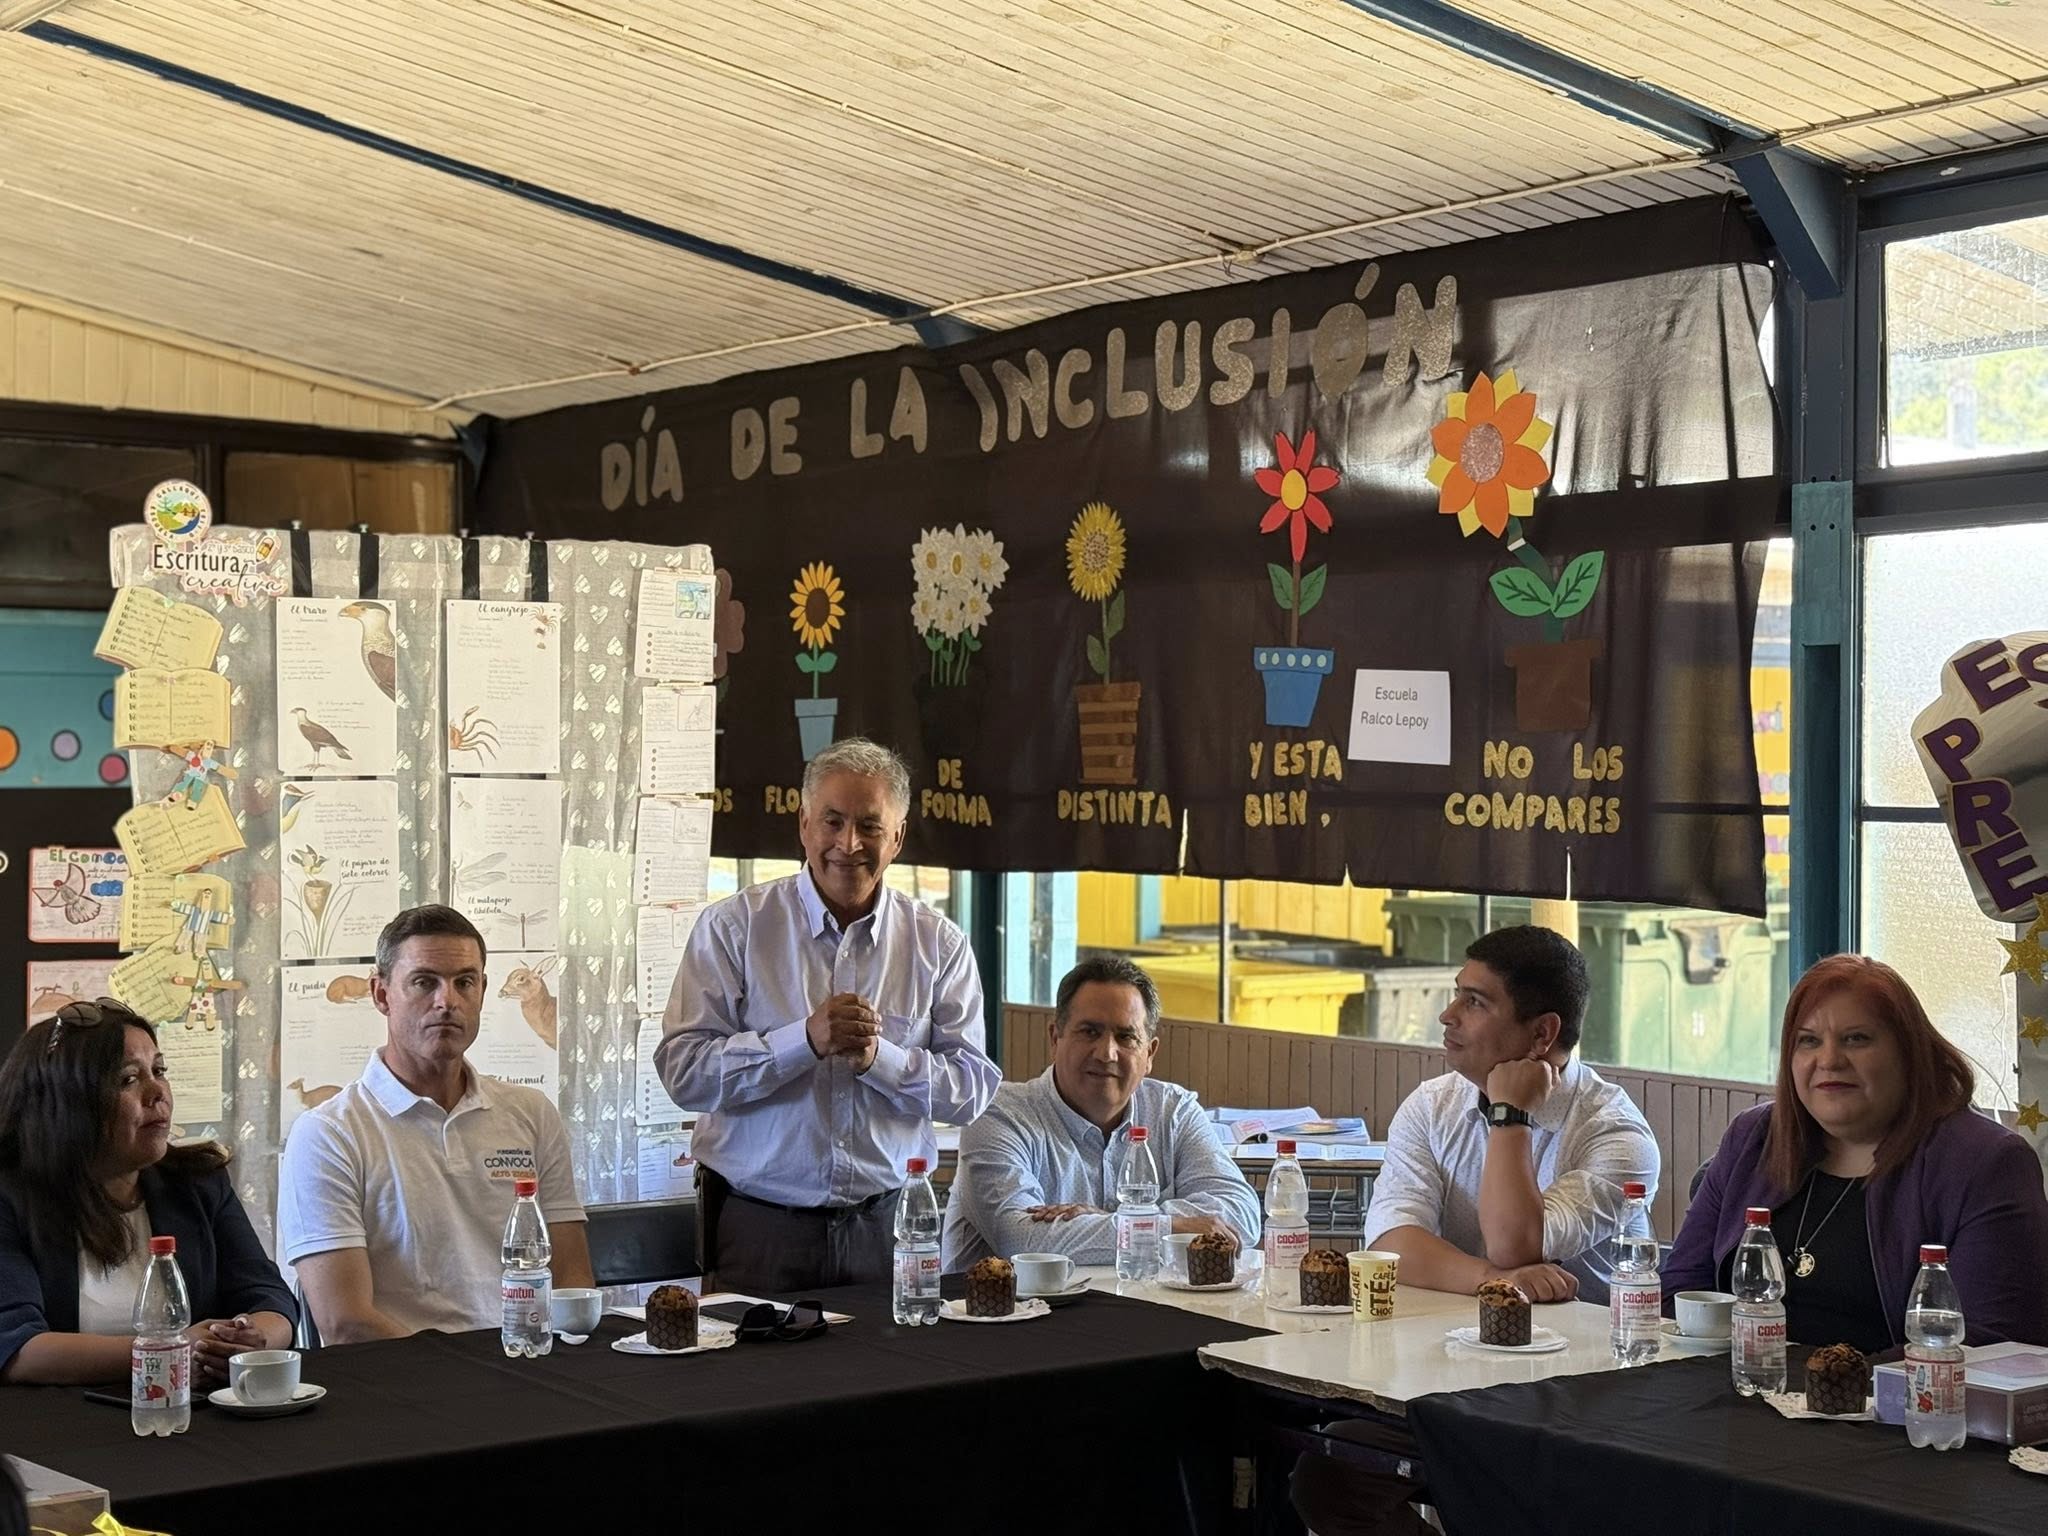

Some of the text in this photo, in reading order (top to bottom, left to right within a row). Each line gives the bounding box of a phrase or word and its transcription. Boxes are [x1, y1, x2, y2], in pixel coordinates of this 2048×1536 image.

[601, 262, 1457, 511] DÍA DE LA INCLUSIÓN
[153, 544, 241, 573] Escritura
[186, 562, 282, 601] creativa
[490, 605, 529, 617] cangrejo
[1374, 686, 1419, 702] Escuela
[1360, 711, 1430, 729] Ralco Lepoy
[938, 758, 962, 788] DE
[1249, 739, 1343, 782] Y ESTA
[1483, 740, 1624, 781] NO LOS
[711, 784, 801, 815] OS FLO
[921, 789, 992, 828] FORMA
[1057, 788, 1173, 830] DISTINTA
[1444, 791, 1621, 834] COMPARES
[484, 1156, 535, 1168] CONVOCA
